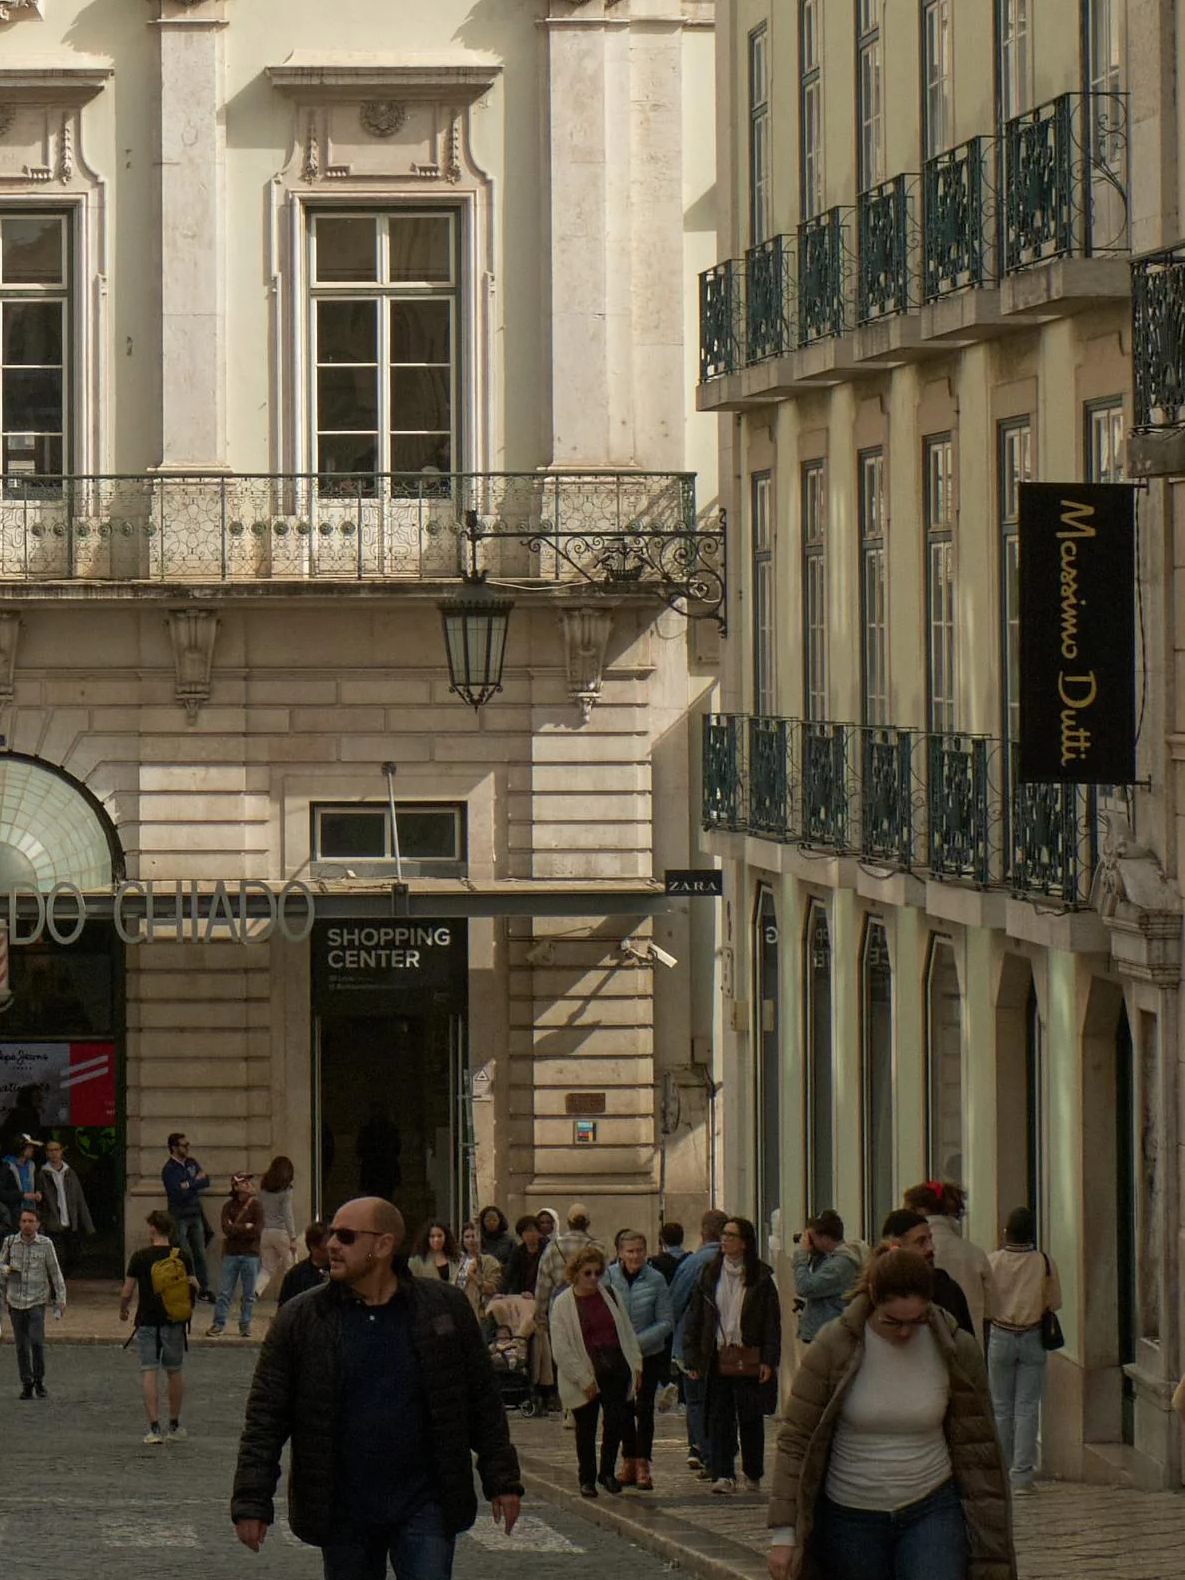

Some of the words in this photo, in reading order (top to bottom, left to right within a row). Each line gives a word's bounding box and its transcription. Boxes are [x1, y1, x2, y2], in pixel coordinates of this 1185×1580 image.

[1055, 499, 1096, 660] Massimo
[1058, 670, 1097, 767] Dutti
[668, 881, 720, 892] ZARA
[9, 880, 87, 946] DO
[113, 880, 317, 946] CHIADO
[327, 927, 452, 947] SHOPPING
[327, 950, 421, 968] CENTER
